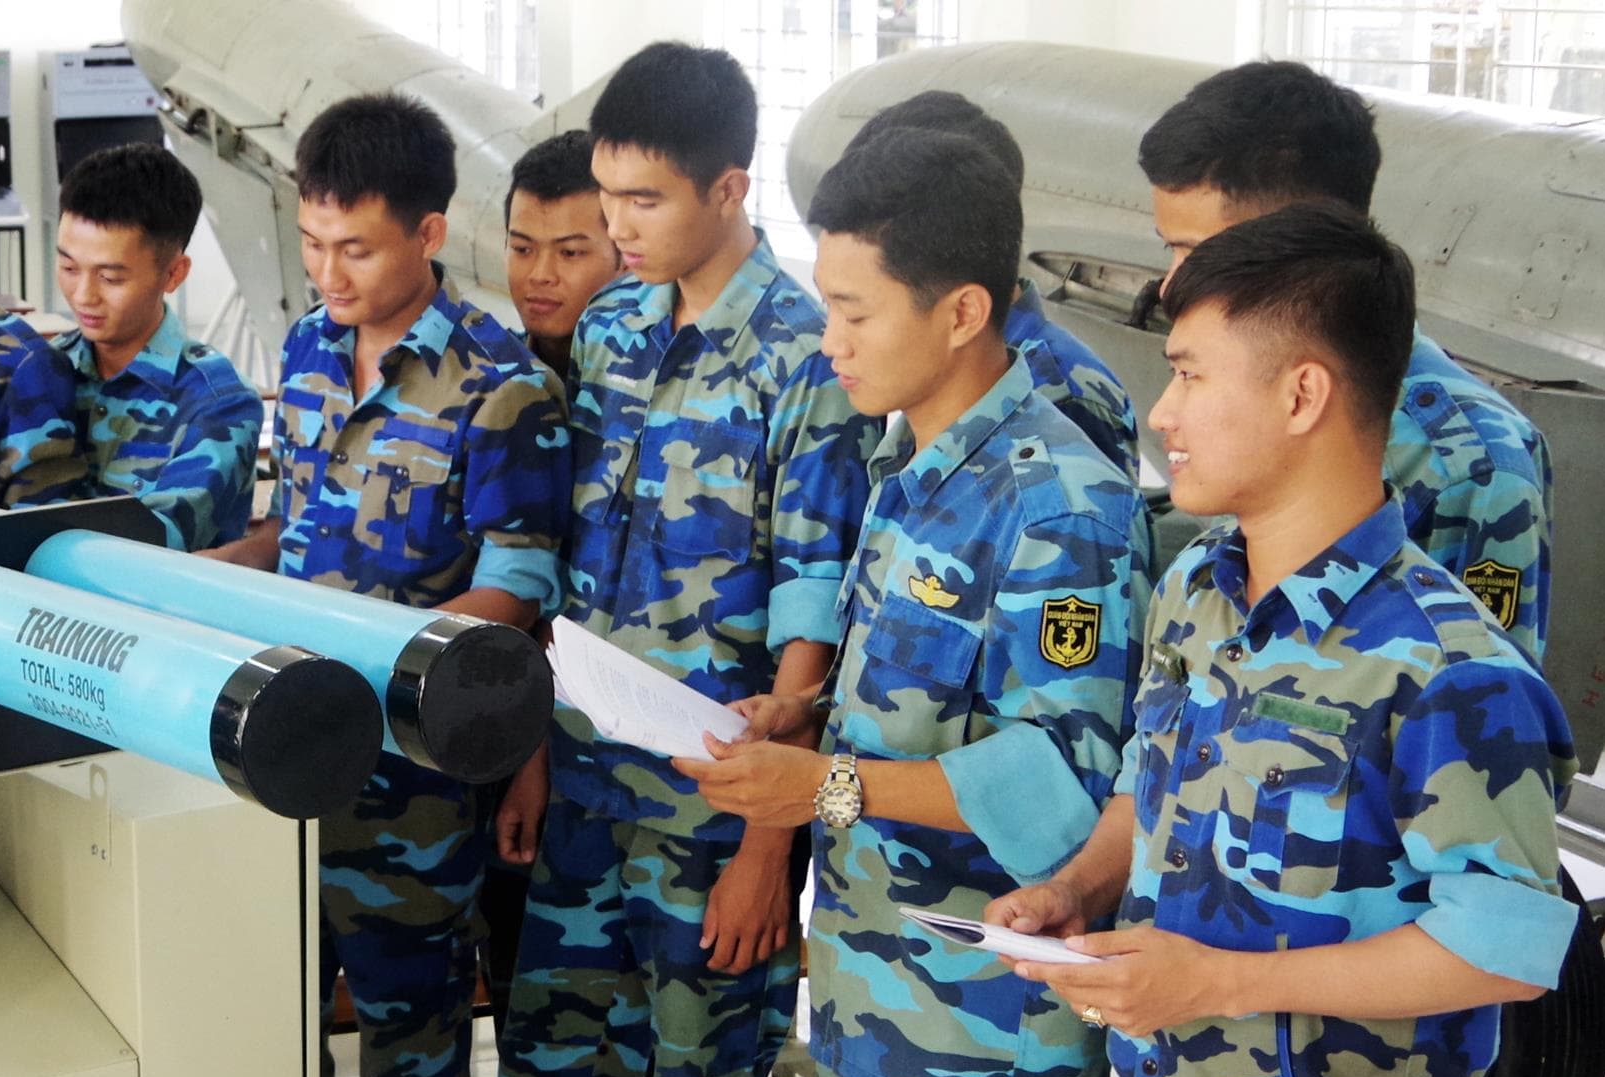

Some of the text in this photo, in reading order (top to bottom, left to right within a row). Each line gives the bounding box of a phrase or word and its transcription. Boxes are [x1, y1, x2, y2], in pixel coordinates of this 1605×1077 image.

[15, 606, 140, 673] TRAINING
[20, 658, 106, 711] TOTAL: 580kg
